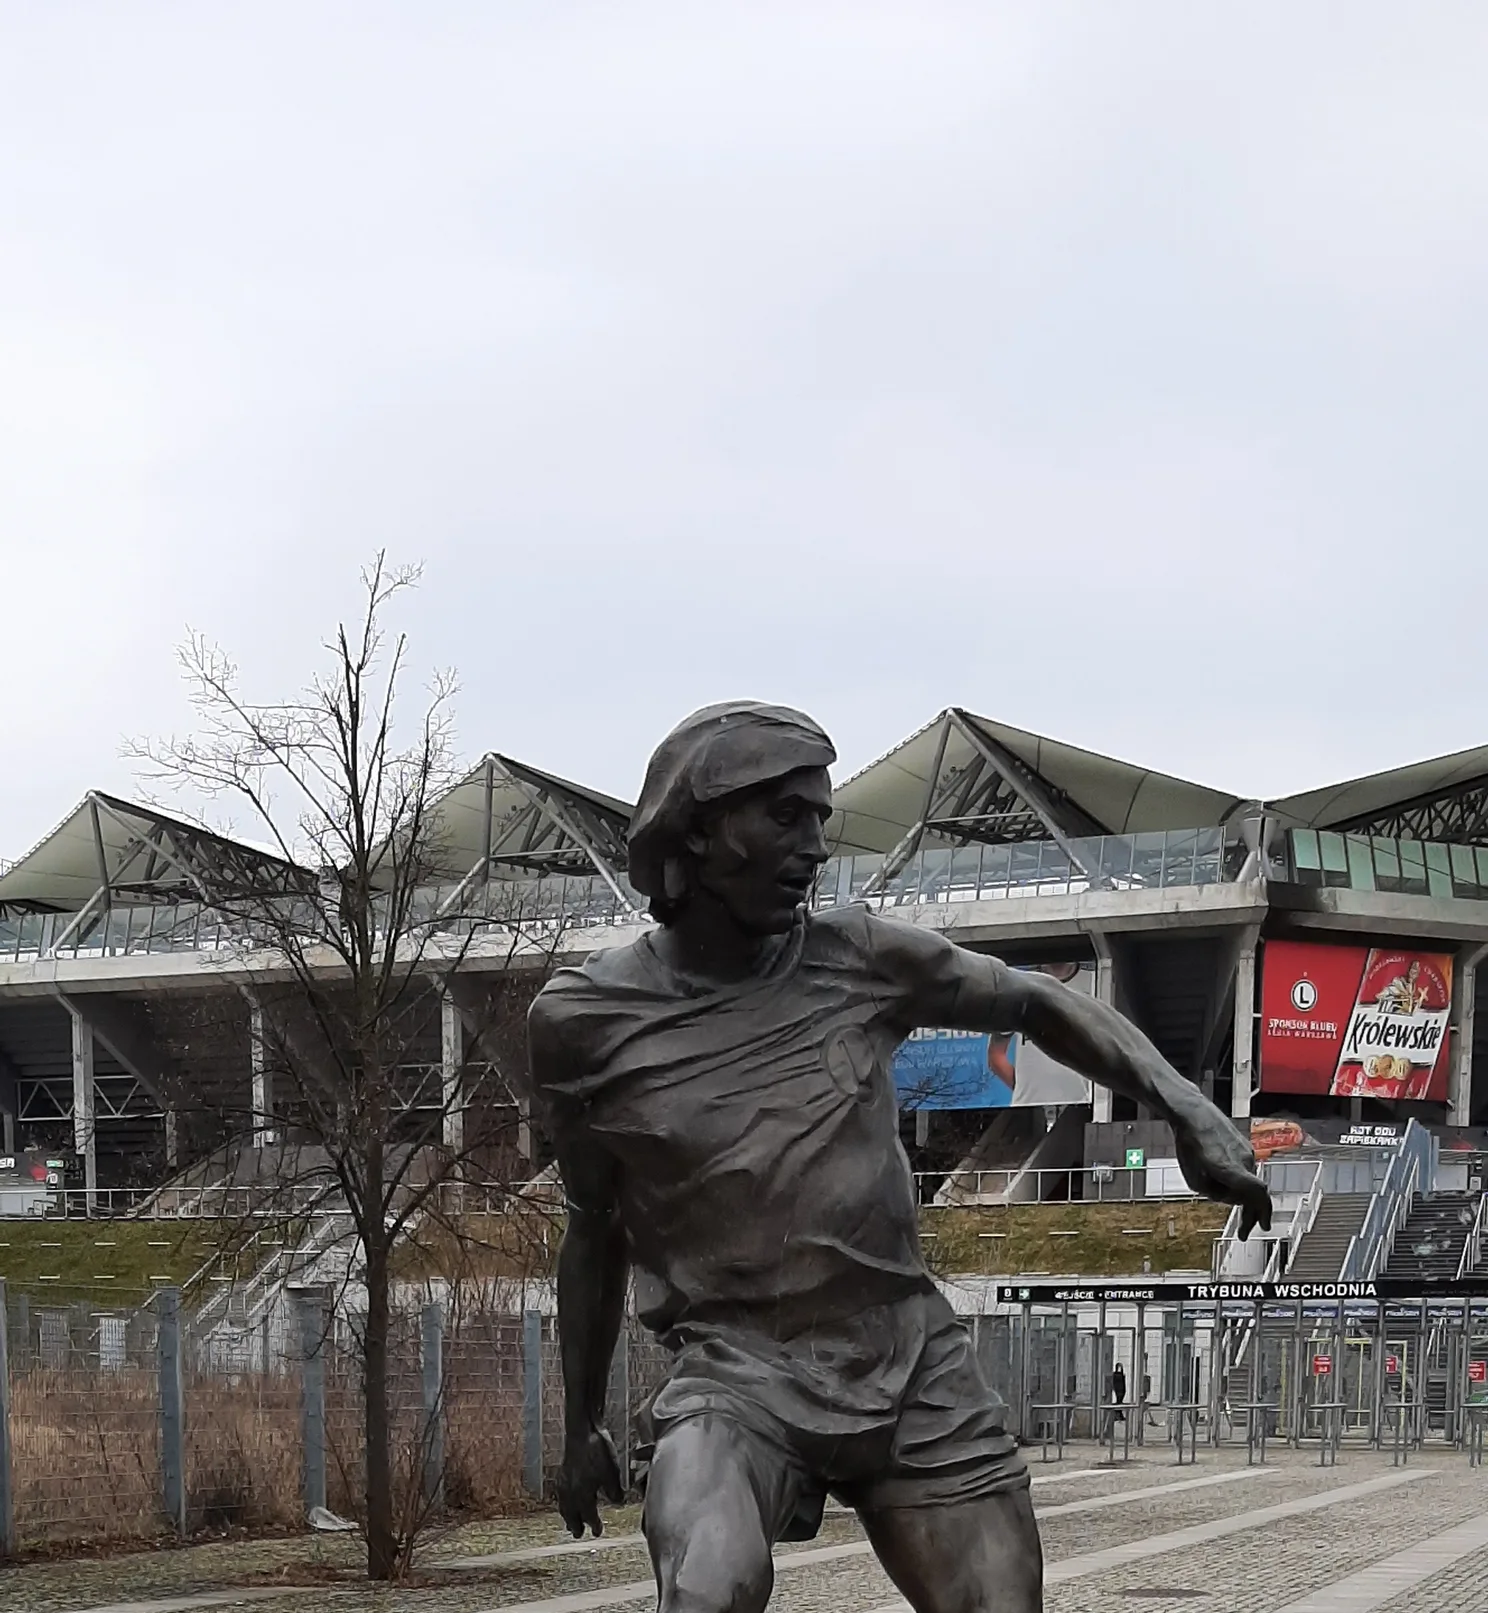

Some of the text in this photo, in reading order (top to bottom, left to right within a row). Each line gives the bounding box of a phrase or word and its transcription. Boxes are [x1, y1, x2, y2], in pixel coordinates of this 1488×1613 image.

[1346, 1012, 1441, 1055] Królewskie
[1187, 1283, 1378, 1298] TRYBUNA WSCHODNIA
